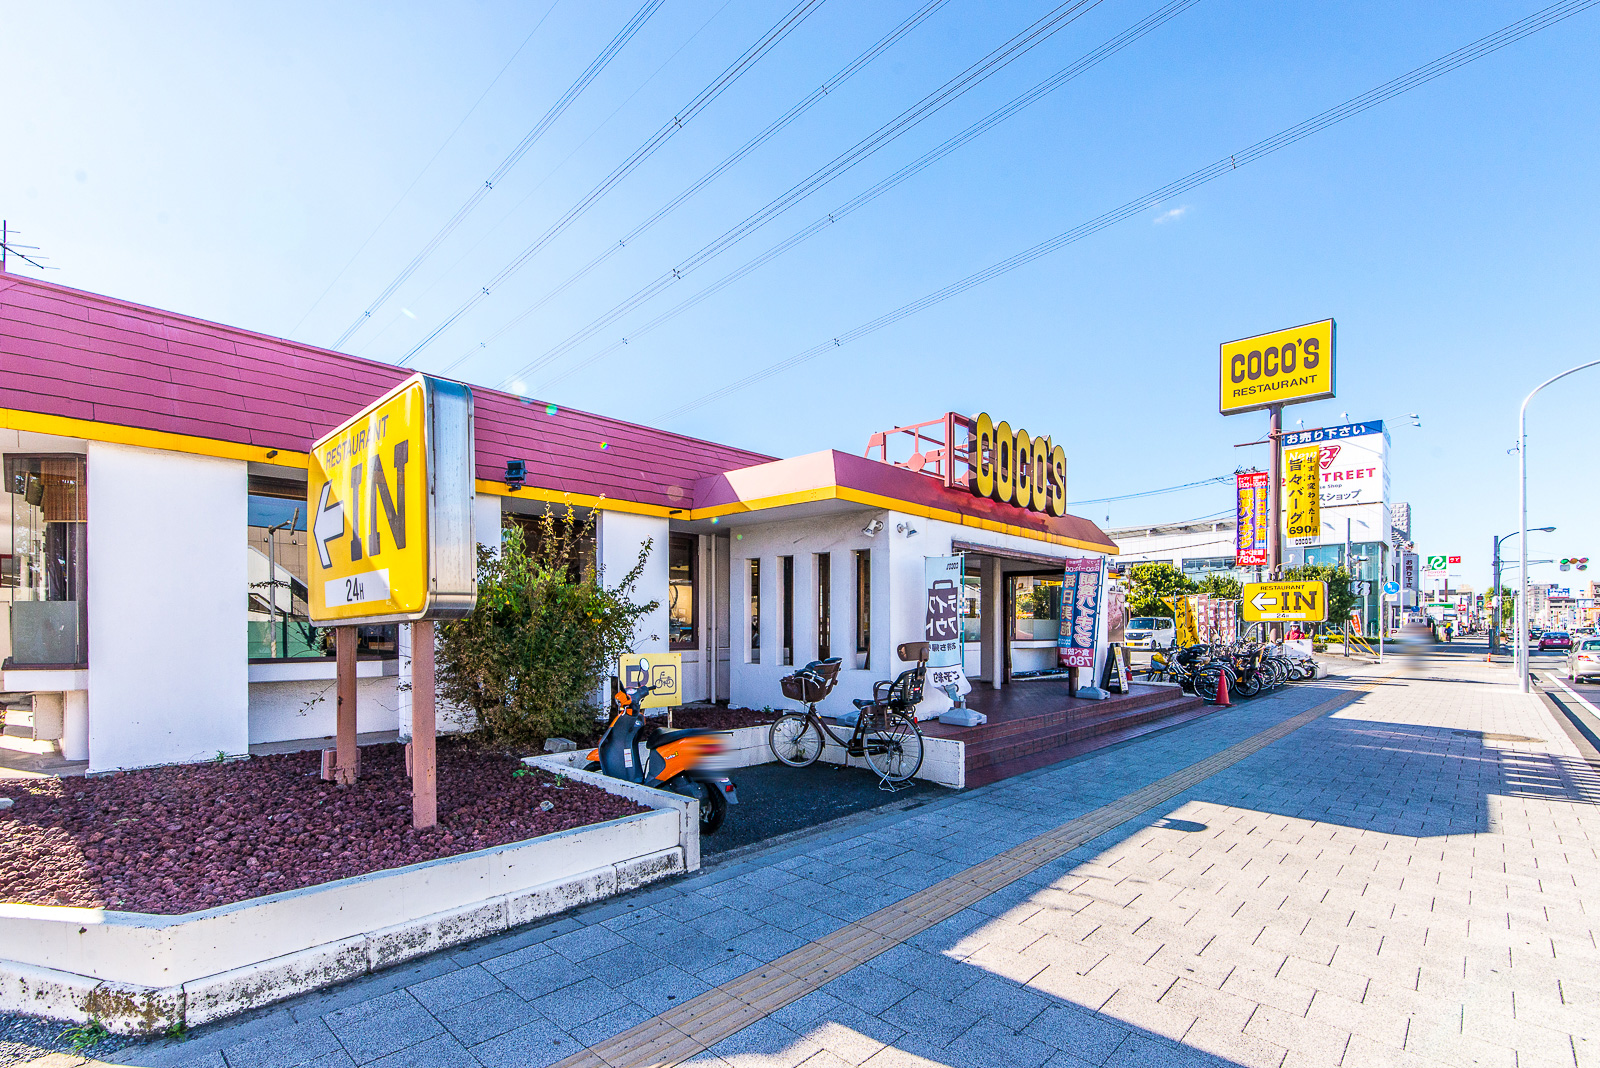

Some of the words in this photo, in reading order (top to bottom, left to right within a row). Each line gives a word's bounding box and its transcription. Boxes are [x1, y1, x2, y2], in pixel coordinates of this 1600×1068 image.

[1230, 337, 1320, 384] COCO'S
[1232, 374, 1318, 398] RESTAURANT
[326, 414, 389, 471] RESTAURANT
[1286, 425, 1366, 445] お売り下さい
[975, 411, 1066, 517] COCO'S
[1288, 451, 1318, 464] New
[1320, 467, 1377, 483] TREET
[350, 439, 409, 562] IN
[1288, 458, 1305, 525] 旨々バーグ
[345, 577, 365, 602] 24H
[1281, 591, 1318, 610] IN
[625, 665, 650, 688] P
